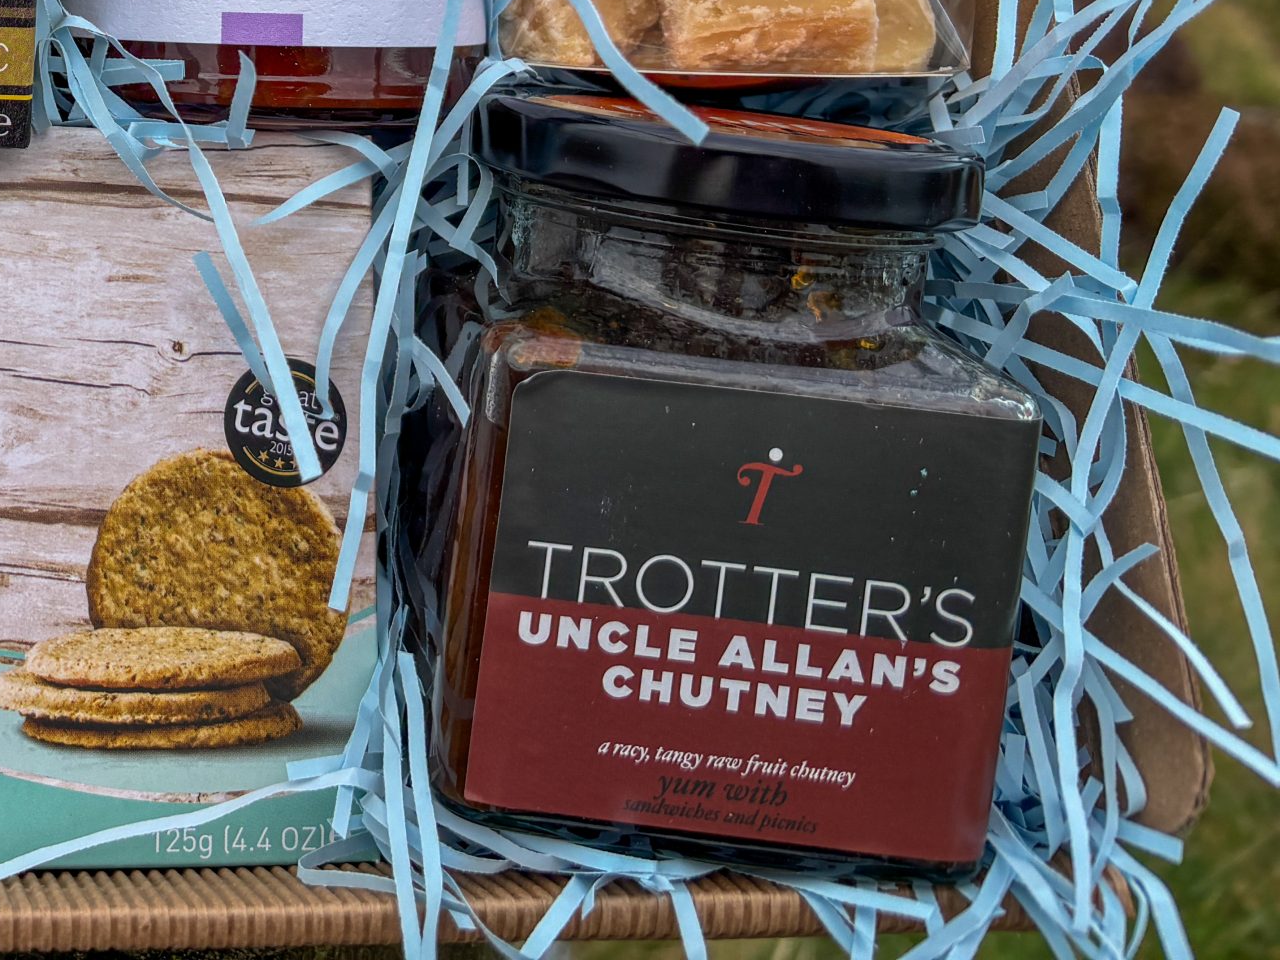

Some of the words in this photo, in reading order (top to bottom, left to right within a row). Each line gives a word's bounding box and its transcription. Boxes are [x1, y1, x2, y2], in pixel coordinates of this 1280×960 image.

[526, 540, 977, 649] TROTTER'S
[516, 611, 698, 664] UNCLE
[718, 635, 963, 695] ALLAN'S
[601, 665, 869, 728] CHUTNEY
[597, 741, 611, 755] a
[612, 742, 651, 763] racy,
[654, 745, 704, 770] tangy
[706, 753, 743, 770] raw
[740, 753, 788, 776] fruit
[789, 759, 857, 789] chutney
[653, 774, 716, 802] yum
[723, 777, 789, 808] with
[624, 796, 721, 824] sandwiches
[723, 811, 763, 827] and
[755, 812, 818, 836] picnics
[153, 827, 214, 859] 125g
[223, 824, 272, 855] (4.4
